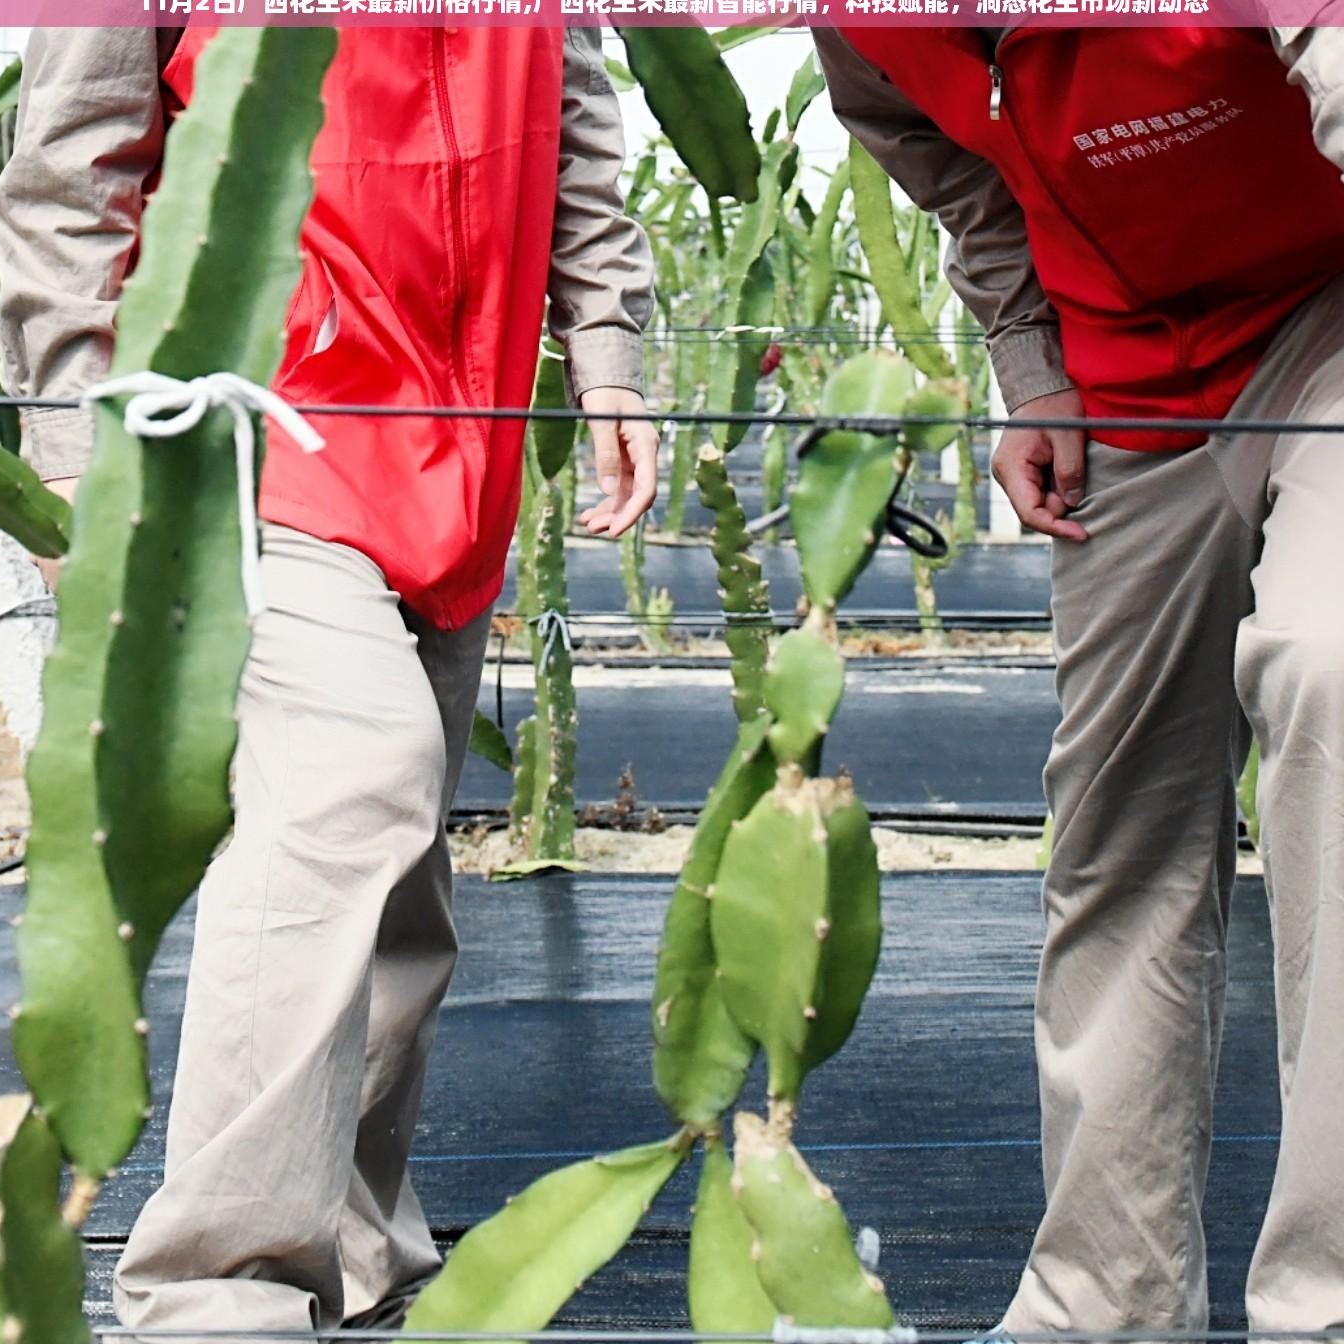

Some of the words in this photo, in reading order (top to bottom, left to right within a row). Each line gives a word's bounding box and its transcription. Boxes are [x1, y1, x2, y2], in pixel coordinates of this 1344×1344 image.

[1072, 97, 1229, 151] 国家电网福建电力
